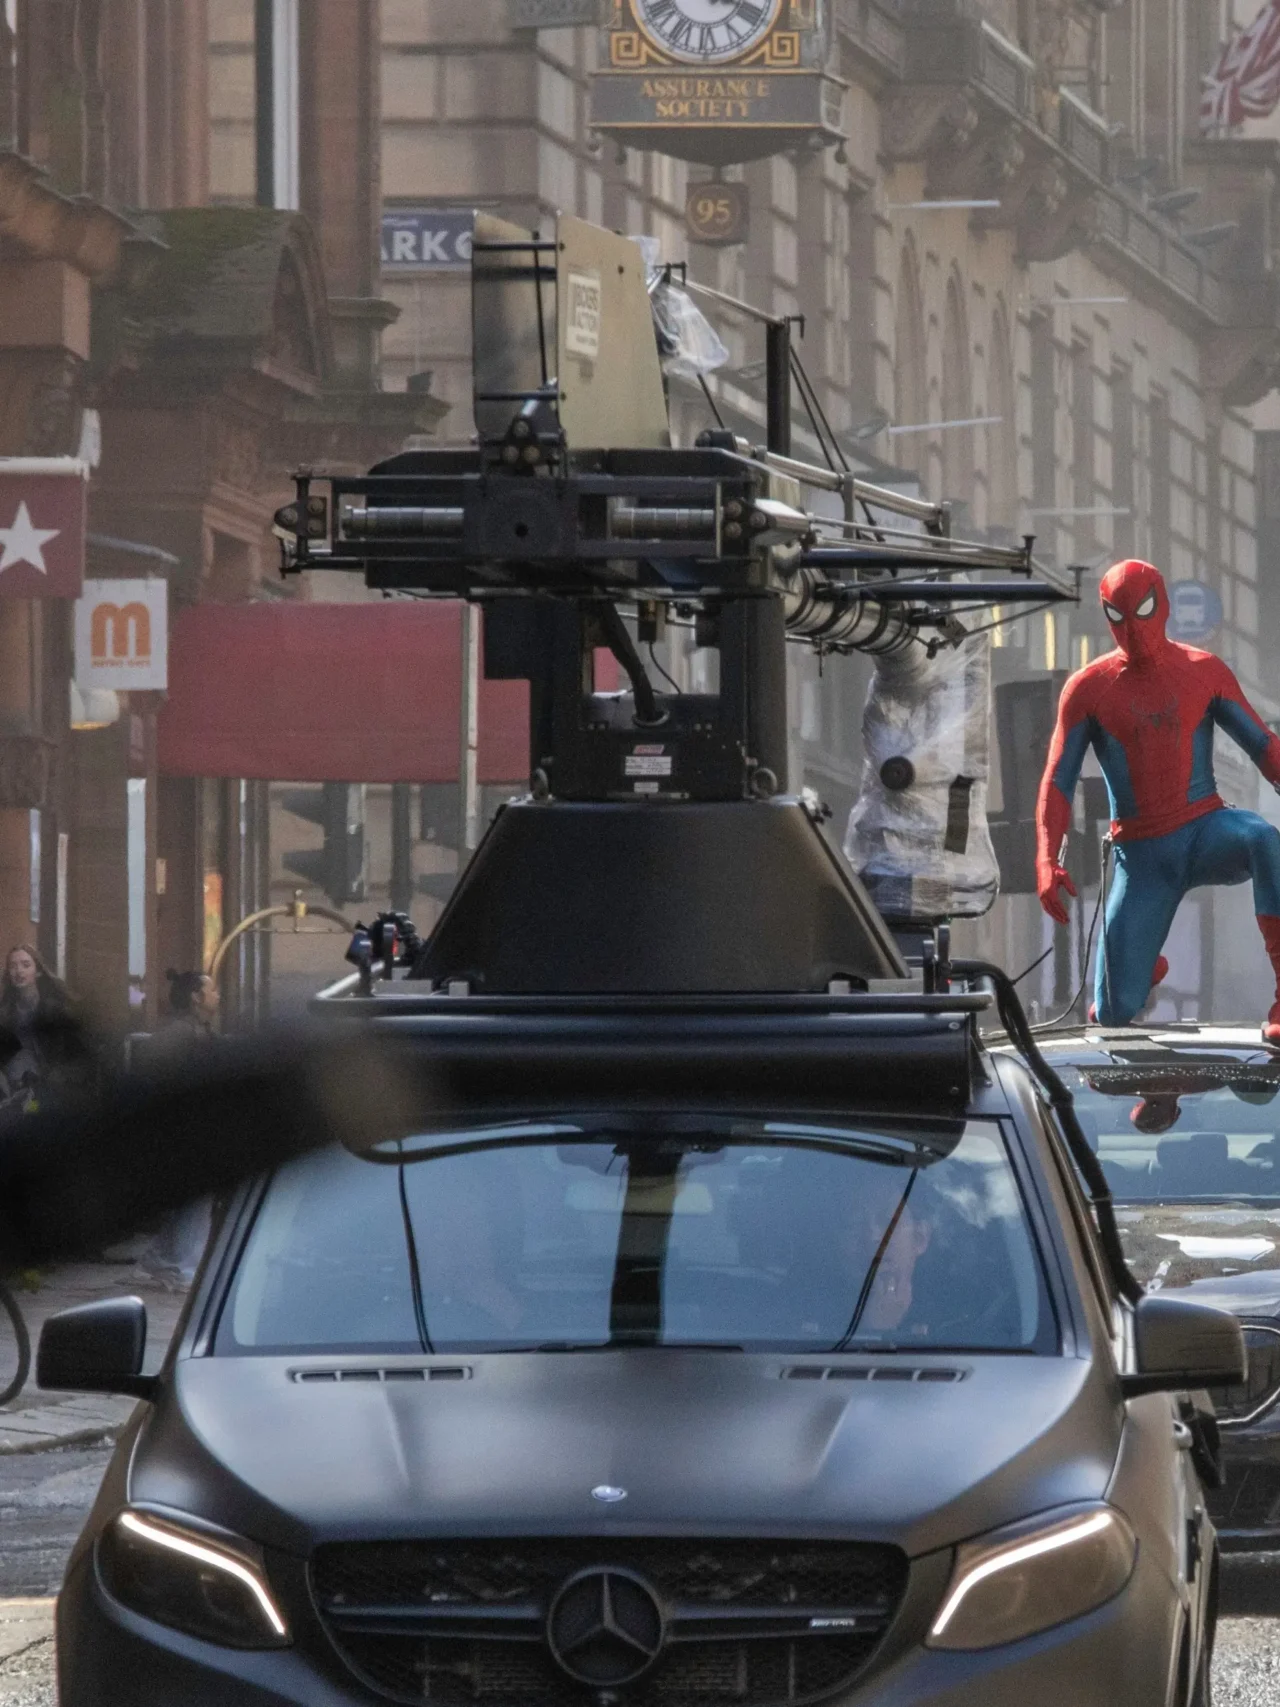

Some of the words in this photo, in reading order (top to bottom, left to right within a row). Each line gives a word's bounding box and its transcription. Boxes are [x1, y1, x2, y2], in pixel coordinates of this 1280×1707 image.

[641, 79, 770, 98] ASSURANCE
[655, 100, 749, 118] SOCIETY
[696, 199, 731, 225] 95
